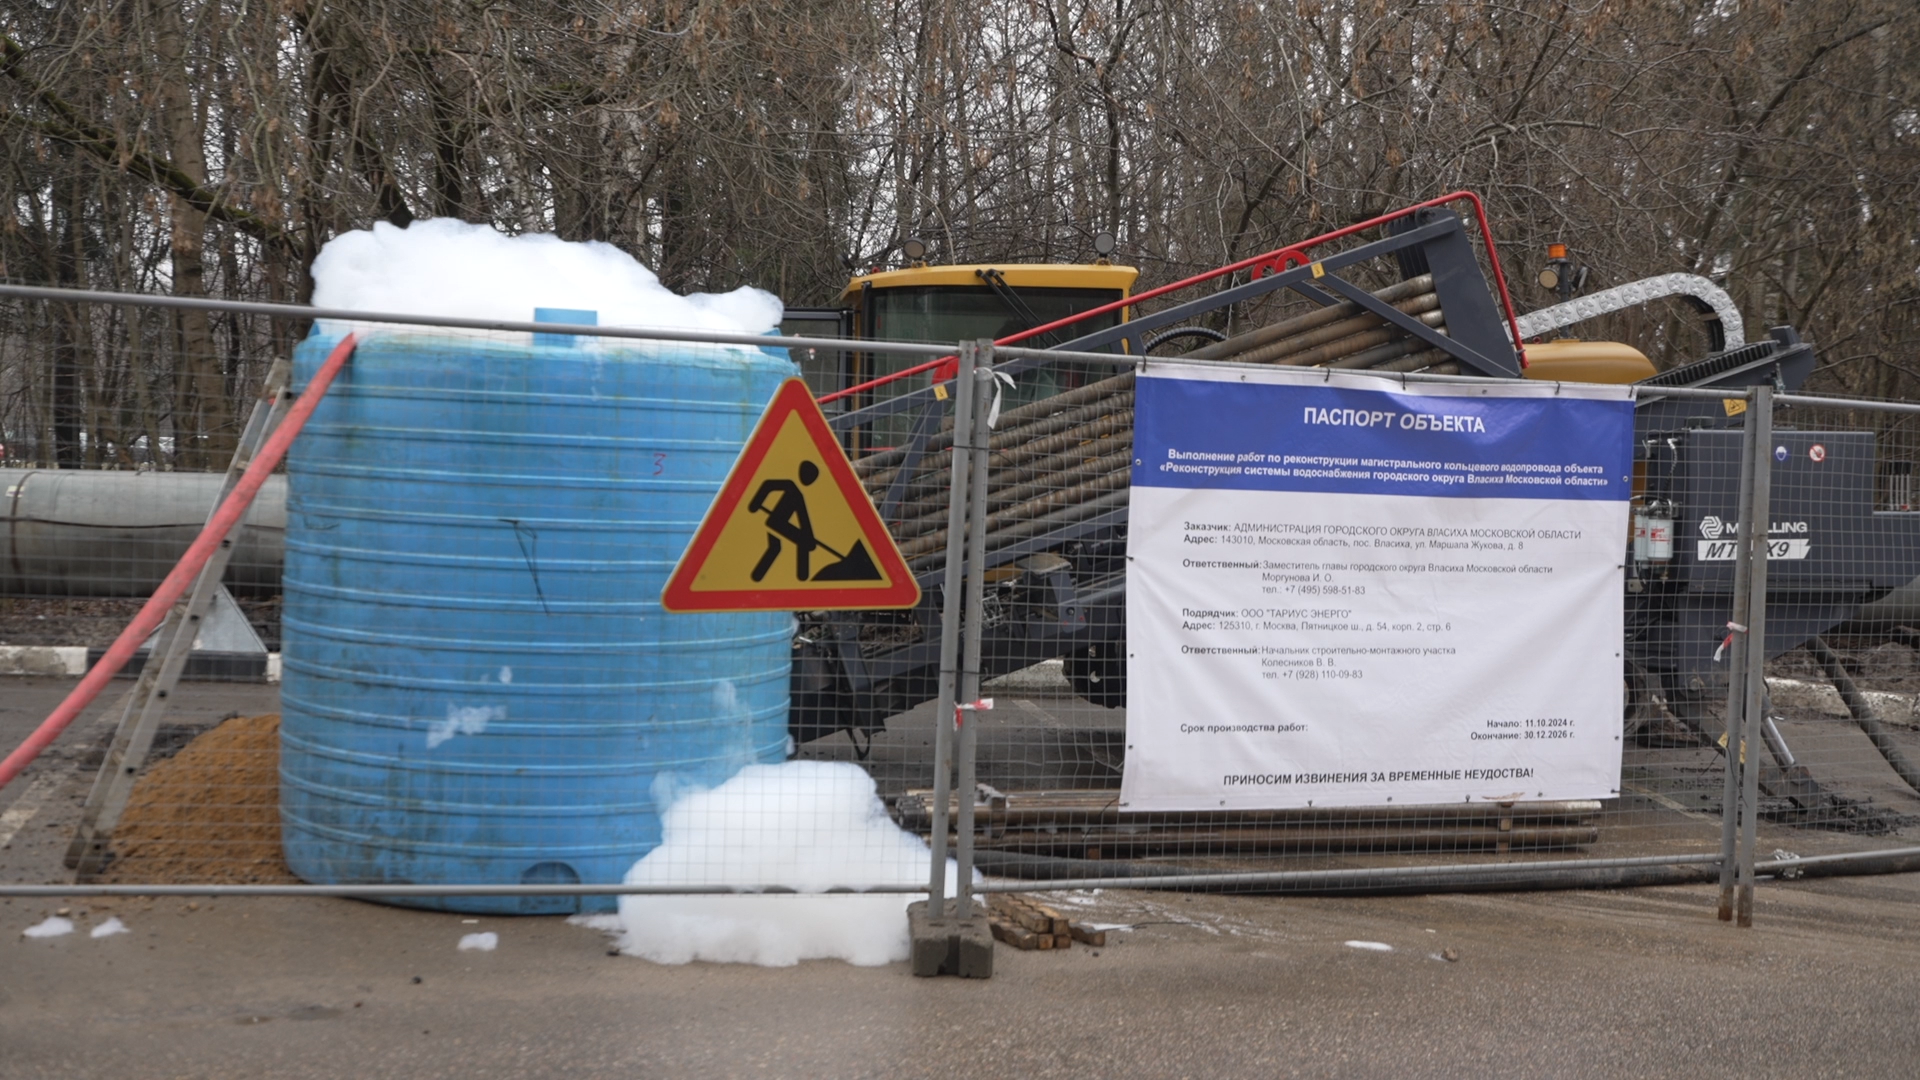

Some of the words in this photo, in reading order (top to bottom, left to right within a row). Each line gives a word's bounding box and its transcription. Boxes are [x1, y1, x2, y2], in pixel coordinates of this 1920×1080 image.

[1304, 407, 1396, 428] ПАСПОРТ
[1400, 413, 1486, 433] ОБЪЕКТА
[653, 452, 666, 476] 3
[1168, 449, 1235, 462] Выполнение
[1237, 452, 1265, 463] работ
[1268, 454, 1281, 463] по
[1284, 455, 1358, 467] реконструкции
[1361, 458, 1441, 470] магистрального
[1444, 462, 1499, 473] кольцевого
[1501, 464, 1561, 474] водопровода
[1564, 464, 1603, 474] объекта
[1160, 462, 1242, 476] «Реконструкция
[1244, 466, 1290, 477] системы
[1293, 468, 1371, 479] водоснабжения
[1373, 471, 1429, 483] городского
[1432, 474, 1465, 484] округа
[1467, 474, 1504, 484] Власиха
[1505, 474, 1562, 485] Московской
[1564, 475, 1608, 486] области»
[1184, 521, 1231, 532] Заказчик:
[1234, 523, 1321, 534] АДМИНИСТРАЦИЯ
[1324, 525, 1388, 536] ГОРОДСКОГО
[1390, 527, 1425, 537] ОКРУГА
[1427, 528, 1468, 538] ВЛАСИХА
[1470, 527, 1535, 538] МОСКОВСКОЙ
[1538, 530, 1581, 539] ОБЛАСТИ
[1184, 534, 1217, 544] Адрес:
[1221, 535, 1255, 546] 143010,
[1258, 536, 1311, 546] Московская
[1313, 537, 1350, 548] область,
[1353, 540, 1371, 548] пос.
[1374, 539, 1412, 549] Власиха,
[1415, 541, 1427, 550] ул.
[1429, 540, 1469, 550] Маршала
[1471, 541, 1505, 551] Жукова,
[1508, 543, 1517, 551] д.
[1518, 541, 1523, 550] 8
[1183, 559, 1262, 569] Ответственный:
[1263, 561, 1320, 571] Заместитель
[1322, 562, 1347, 570] главы
[1350, 563, 1397, 573] городского
[1399, 564, 1425, 573] округа
[1428, 563, 1464, 573] Власиха
[1466, 563, 1516, 573] Московской
[1518, 564, 1553, 574] области
[1262, 572, 1310, 583] Моргунова
[1313, 573, 1322, 582] И.
[1324, 573, 1334, 582] О.
[1285, 586, 1295, 594] +7
[1297, 585, 1321, 596] (495)
[1322, 586, 1366, 595] 598-51-83
[1183, 608, 1238, 619] Подрядчик:
[1241, 609, 1264, 618] ООО
[1266, 609, 1308, 619] "ТАРИУС
[1310, 609, 1351, 619] ЭНЕРГО"
[1182, 621, 1215, 631] Адрес:
[1219, 622, 1253, 632] 125310,
[1263, 622, 1299, 632] Москва,
[1301, 622, 1348, 632] Пятницкое
[1366, 623, 1374, 632] д.
[1376, 622, 1389, 632] 54,
[1392, 624, 1414, 632] корп.
[1416, 622, 1424, 632] 2,
[1427, 624, 1443, 633] стр.
[1445, 622, 1451, 631] 6
[1181, 645, 1260, 655] Ответственный:
[1262, 646, 1309, 654] Начальник
[1312, 646, 1421, 656] строительно-монтажного
[1423, 647, 1456, 657] участка
[1262, 658, 1314, 667] Колесников
[1316, 658, 1325, 667] В.
[1328, 658, 1336, 667] В.
[1262, 672, 1279, 680] тел.
[1282, 671, 1293, 679] +7
[1295, 670, 1319, 680] (928)
[1322, 670, 1363, 680] 110-09-83
[1180, 723, 1205, 734] Срок
[1207, 724, 1275, 734] производства
[1277, 723, 1308, 734] работ:
[1487, 719, 1522, 728] Начало:
[1525, 718, 1567, 728] 11.10.2024
[1470, 731, 1522, 740] Окончание:
[1523, 731, 1567, 740] 30.12.2026
[1223, 773, 1292, 786] ПРИНОСИМ
[1295, 772, 1367, 785] ИЗВИНЕНИЯ
[1370, 771, 1385, 783] ЗА
[1388, 769, 1461, 782] ВРЕМЕННЫЕ
[1464, 768, 1534, 781] НЕУДОСТВА!
